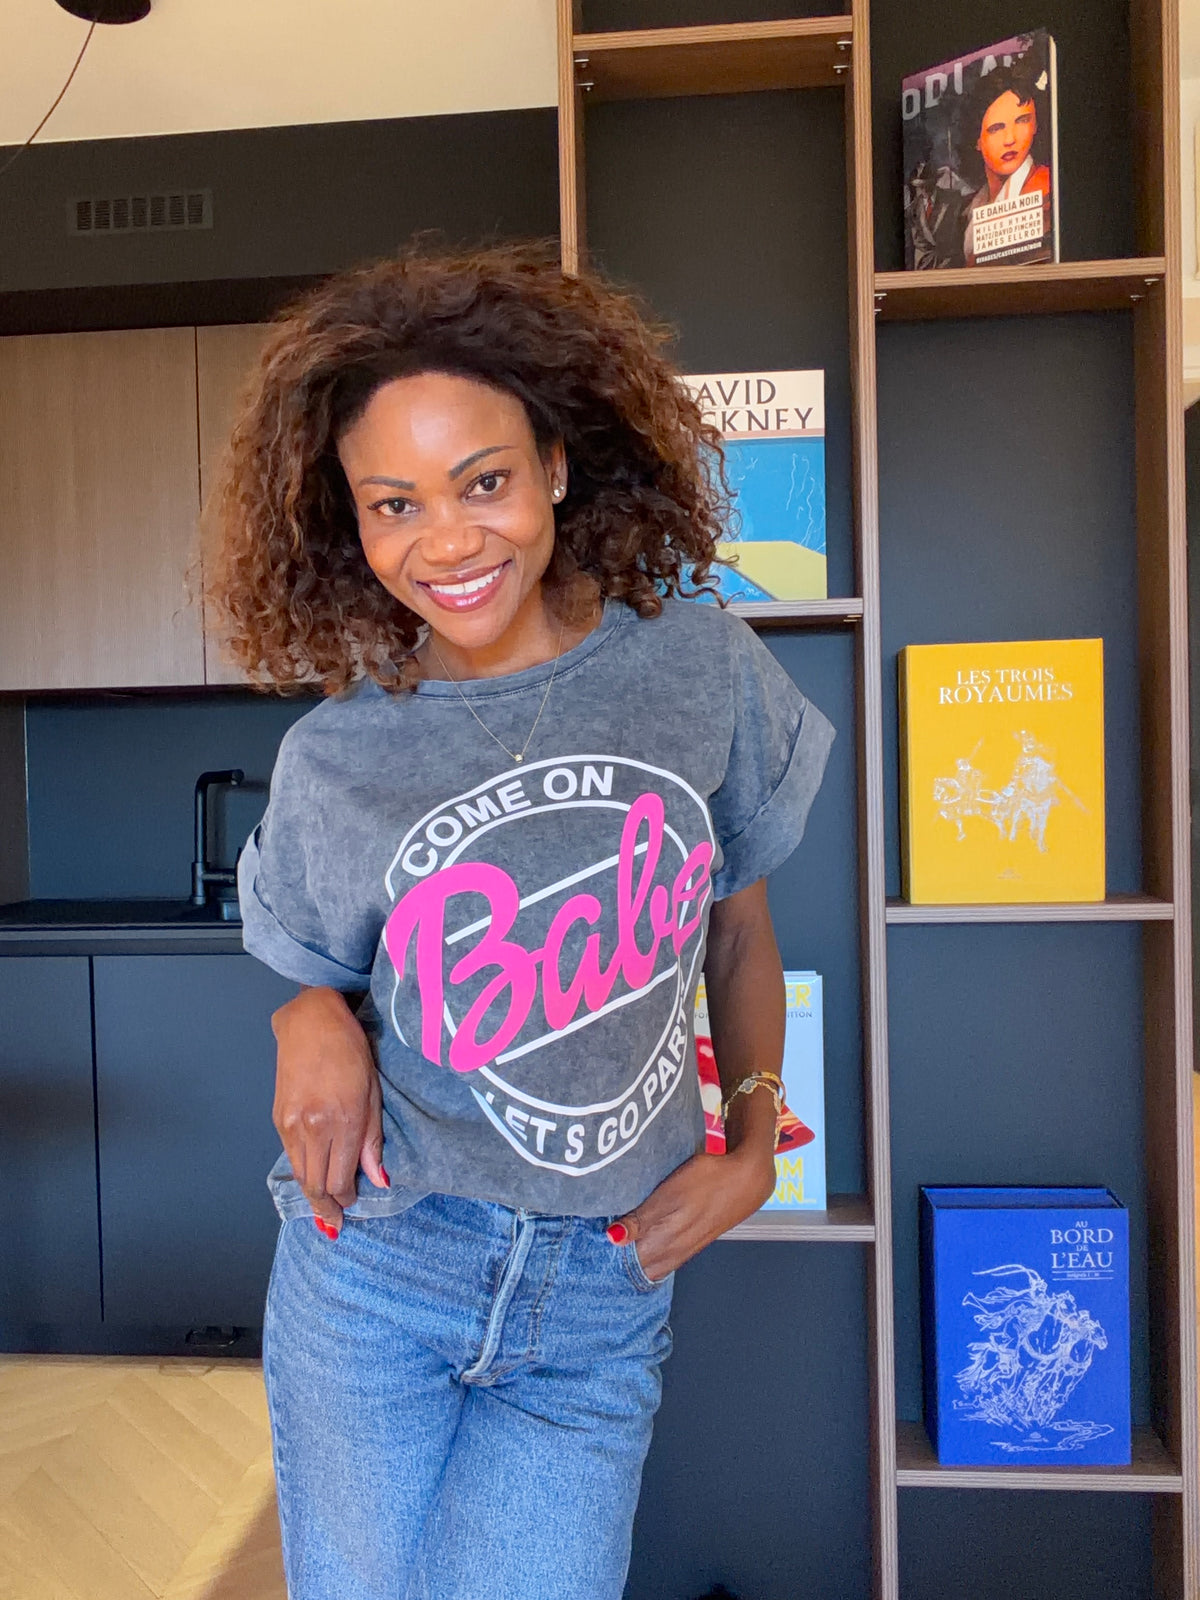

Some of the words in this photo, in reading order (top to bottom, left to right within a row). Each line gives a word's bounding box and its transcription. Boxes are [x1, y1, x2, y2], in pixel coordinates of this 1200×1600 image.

[976, 209, 985, 220] LE
[987, 200, 1017, 217] DAHLIA
[1019, 194, 1040, 208] NOIR
[976, 221, 1004, 234] MILES
[1008, 211, 1041, 225] HYMAN
[1014, 219, 1041, 232] FINCHER
[976, 237, 1005, 251] JAMES
[1008, 227, 1041, 242] ELLROY
[695, 379, 777, 407] AVID
[956, 669, 991, 686] LES
[995, 667, 1055, 684] TROIS
[938, 681, 1073, 705] ROYAUMES
[402, 780, 532, 877] COME
[543, 765, 614, 801] ON
[386, 793, 713, 1073] Babe
[598, 1101, 639, 1155] GO
[1050, 1228, 1114, 1244] BORD
[1075, 1220, 1089, 1228] AU
[1050, 1252, 1113, 1269] L'EAU
